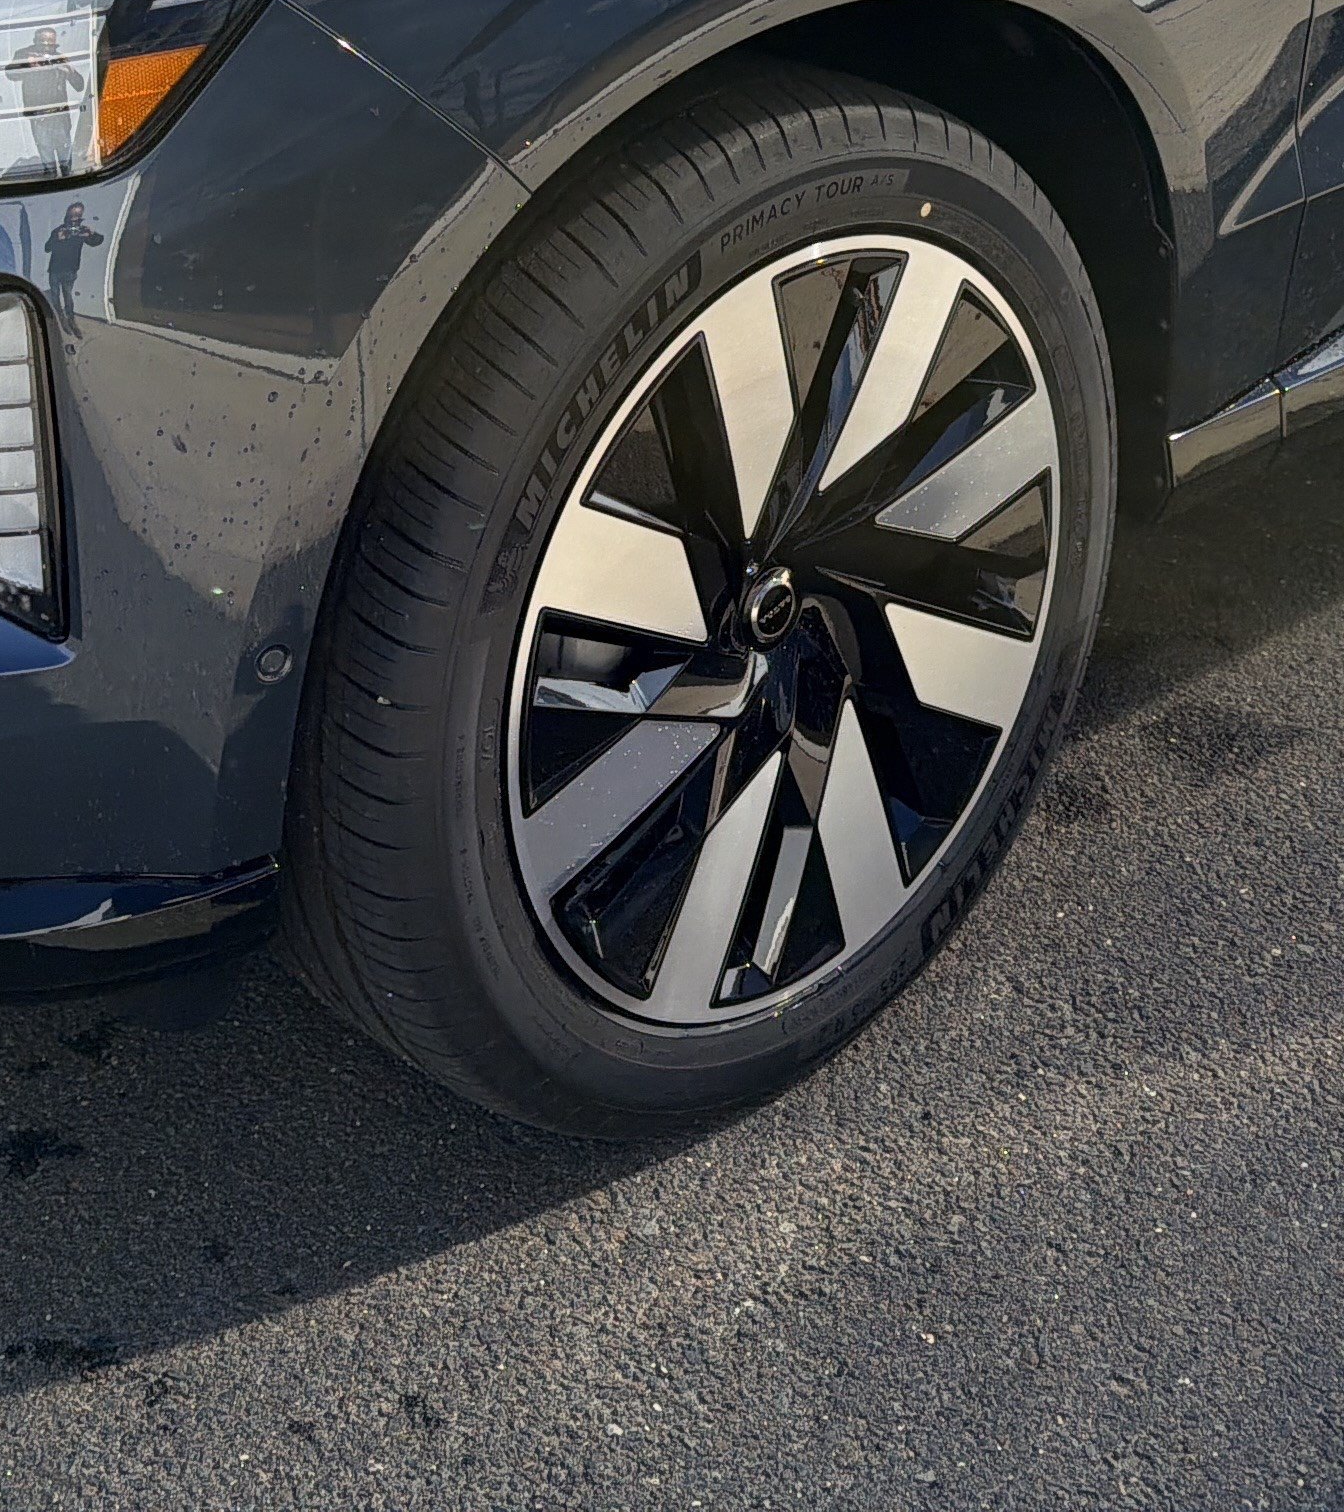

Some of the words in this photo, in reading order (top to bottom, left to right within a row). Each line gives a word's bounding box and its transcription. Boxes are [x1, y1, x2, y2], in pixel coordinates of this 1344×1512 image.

[719, 190, 807, 255] PRIMACY
[814, 175, 865, 204] TOUR
[869, 173, 895, 187] A/S
[514, 262, 691, 532] MICHELIN
